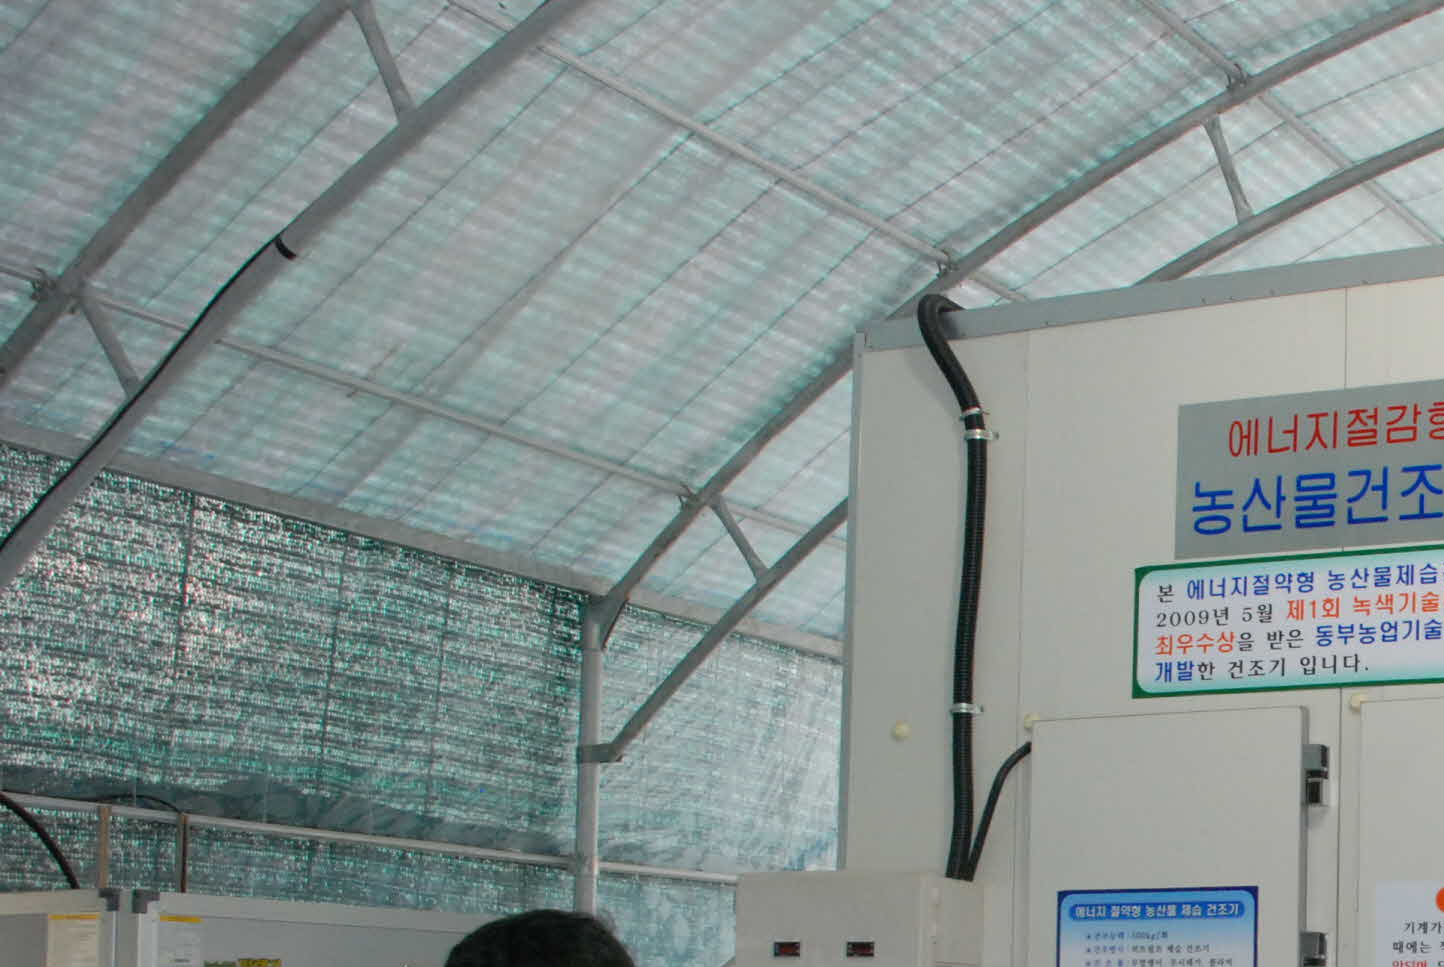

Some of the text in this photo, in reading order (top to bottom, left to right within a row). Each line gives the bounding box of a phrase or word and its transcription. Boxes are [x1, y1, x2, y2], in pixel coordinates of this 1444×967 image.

[1156, 584, 1176, 603] 본
[1186, 571, 1315, 600] 에너지절약형
[1155, 606, 1230, 628] 2009년
[1241, 603, 1273, 624] 5월
[1286, 596, 1341, 620] 제1회
[1154, 632, 1255, 656] 최우수상을
[1266, 629, 1304, 650] 받은
[1154, 653, 1369, 683] 개발한 건조기 입니다.
[1206, 902, 1240, 916] 건조기
[1391, 940, 1433, 954] 때에는
